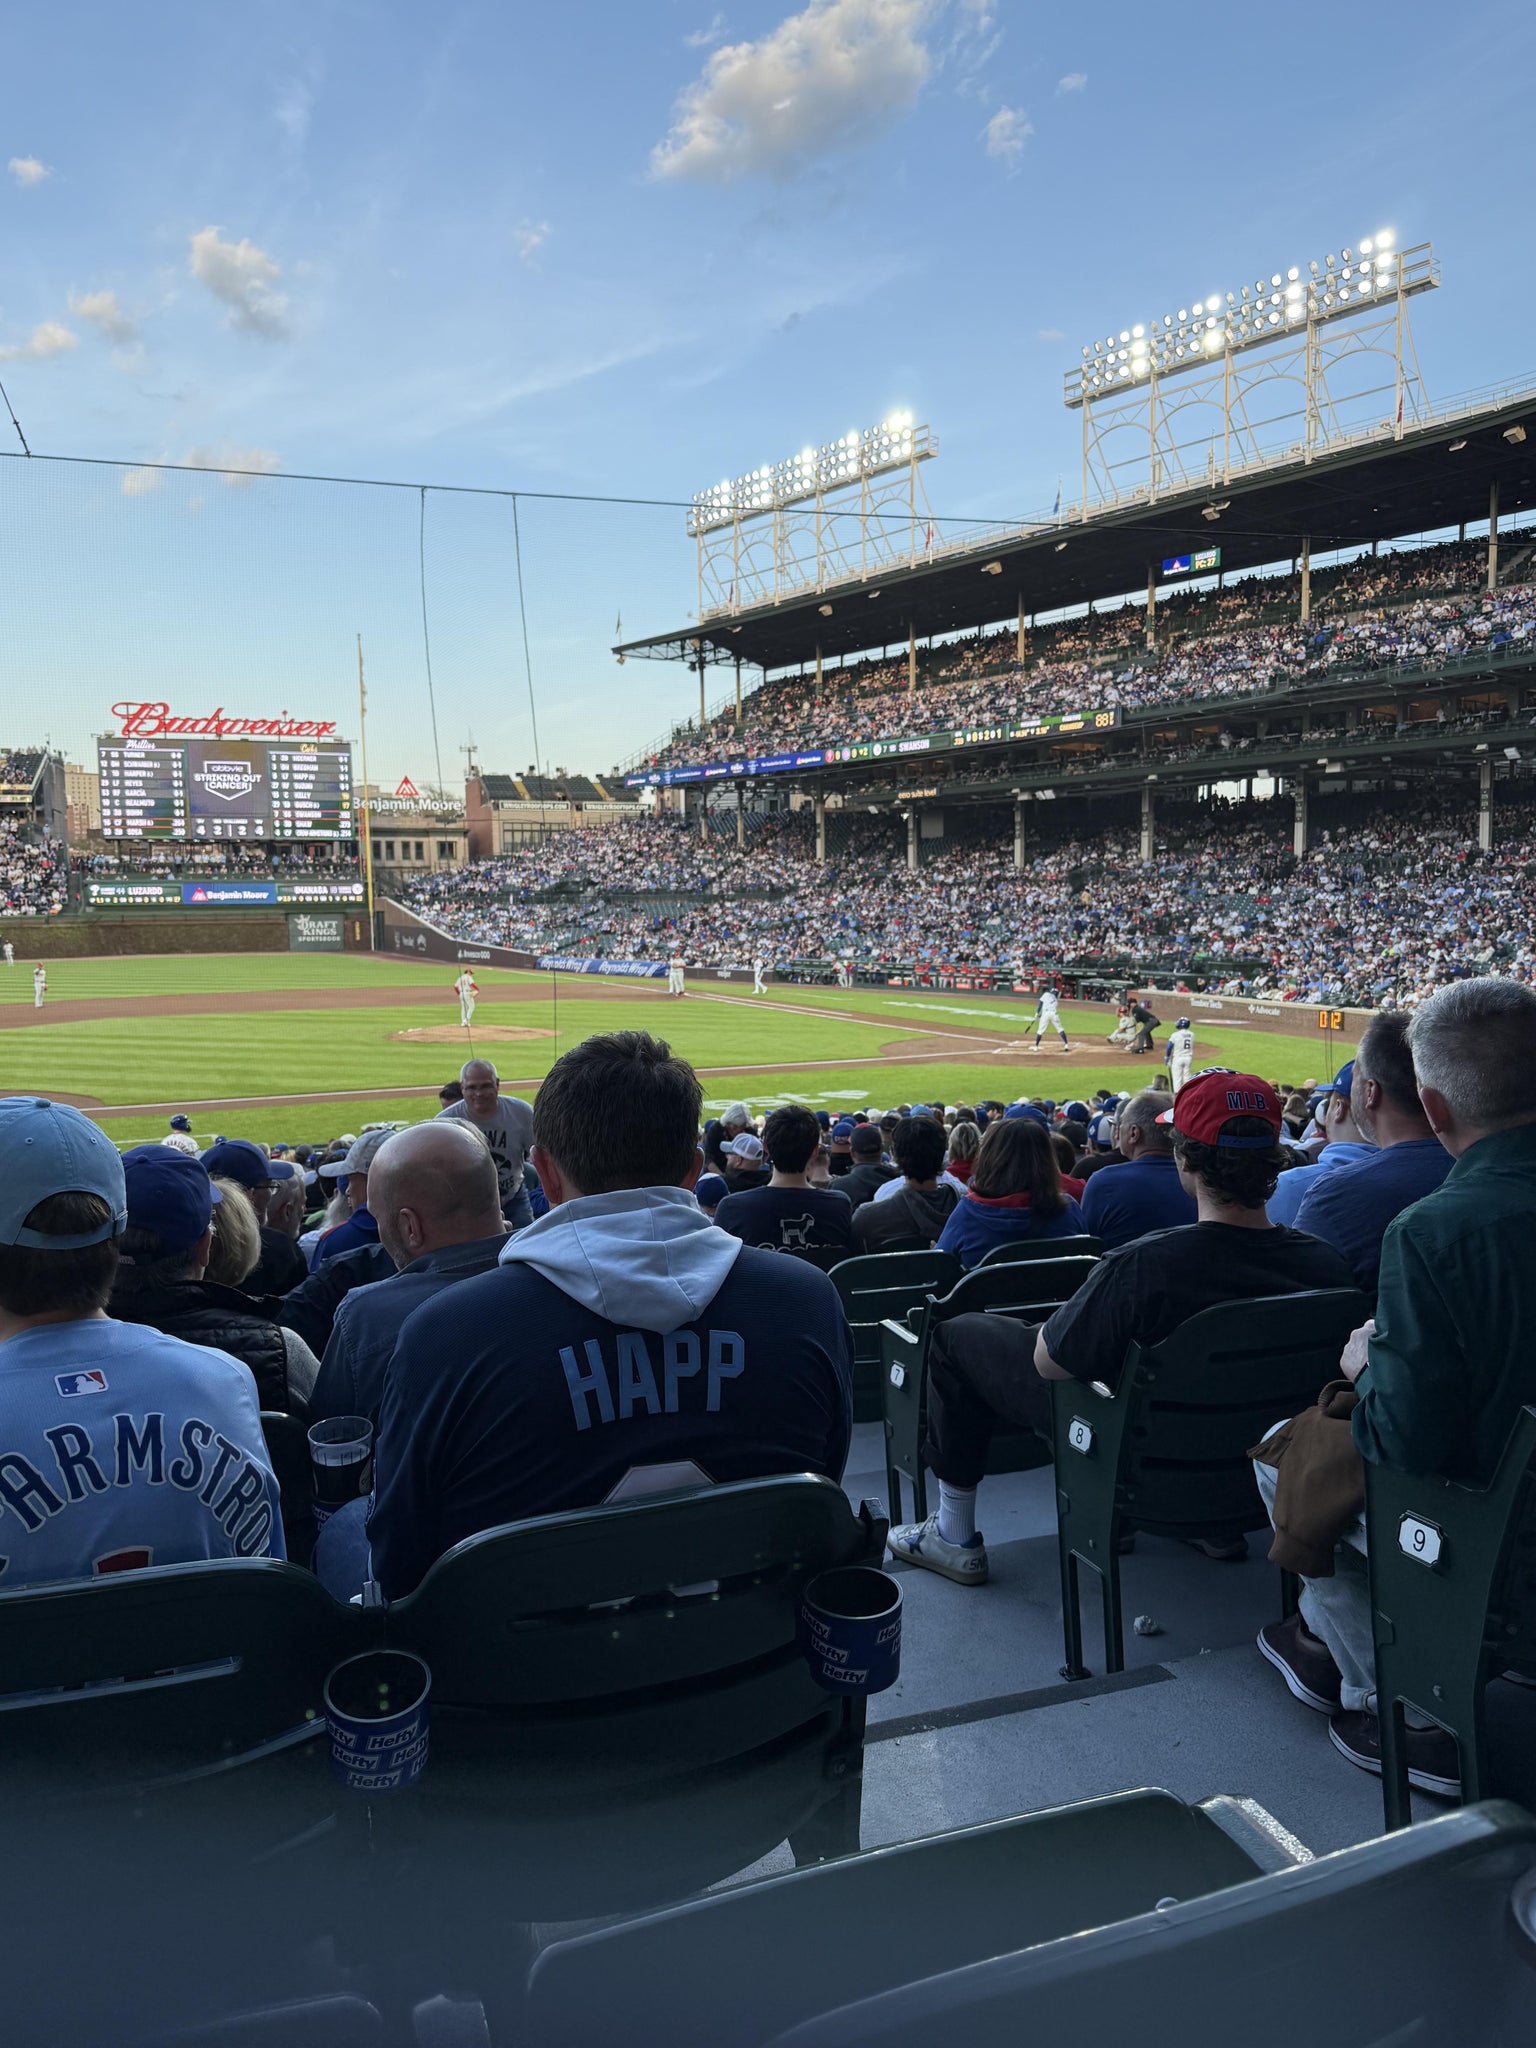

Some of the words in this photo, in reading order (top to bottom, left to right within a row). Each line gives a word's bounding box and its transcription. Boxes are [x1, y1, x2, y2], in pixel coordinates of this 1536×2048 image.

[111, 702, 336, 738] Budweiser
[1095, 714, 1109, 727] 88
[899, 739, 930, 752] SWANSON
[194, 773, 241, 782] STRIKING
[242, 774, 262, 782] OUT
[353, 797, 415, 812] Benjamin
[419, 799, 461, 811] Moore
[196, 825, 206, 835] 4
[213, 825, 222, 835] 2
[238, 825, 246, 836] 2
[254, 825, 264, 836] 4
[128, 886, 163, 895] LUZARDO
[206, 891, 242, 901] Benjamin
[243, 891, 269, 899] Moore
[299, 920, 338, 930] DRAFT
[599, 961, 629, 974] Reynolds
[629, 963, 648, 976] Wrap
[1256, 1006, 1281, 1016] Advocate
[1184, 1039, 1191, 1049] 6
[1226, 1091, 1266, 1110] MLB
[559, 1329, 745, 1431] HAPP
[1076, 1428, 1084, 1444] 8
[0, 1412, 272, 1557] ARMSTRO
[1413, 1529, 1426, 1552] 9
[812, 1638, 847, 1662] Hefty
[824, 1664, 866, 1683] Hefty
[328, 1723, 355, 1745] efty
[369, 1725, 418, 1749] Hefty
[334, 1747, 377, 1770] Hefty
[351, 1773, 400, 1788] Hefty
